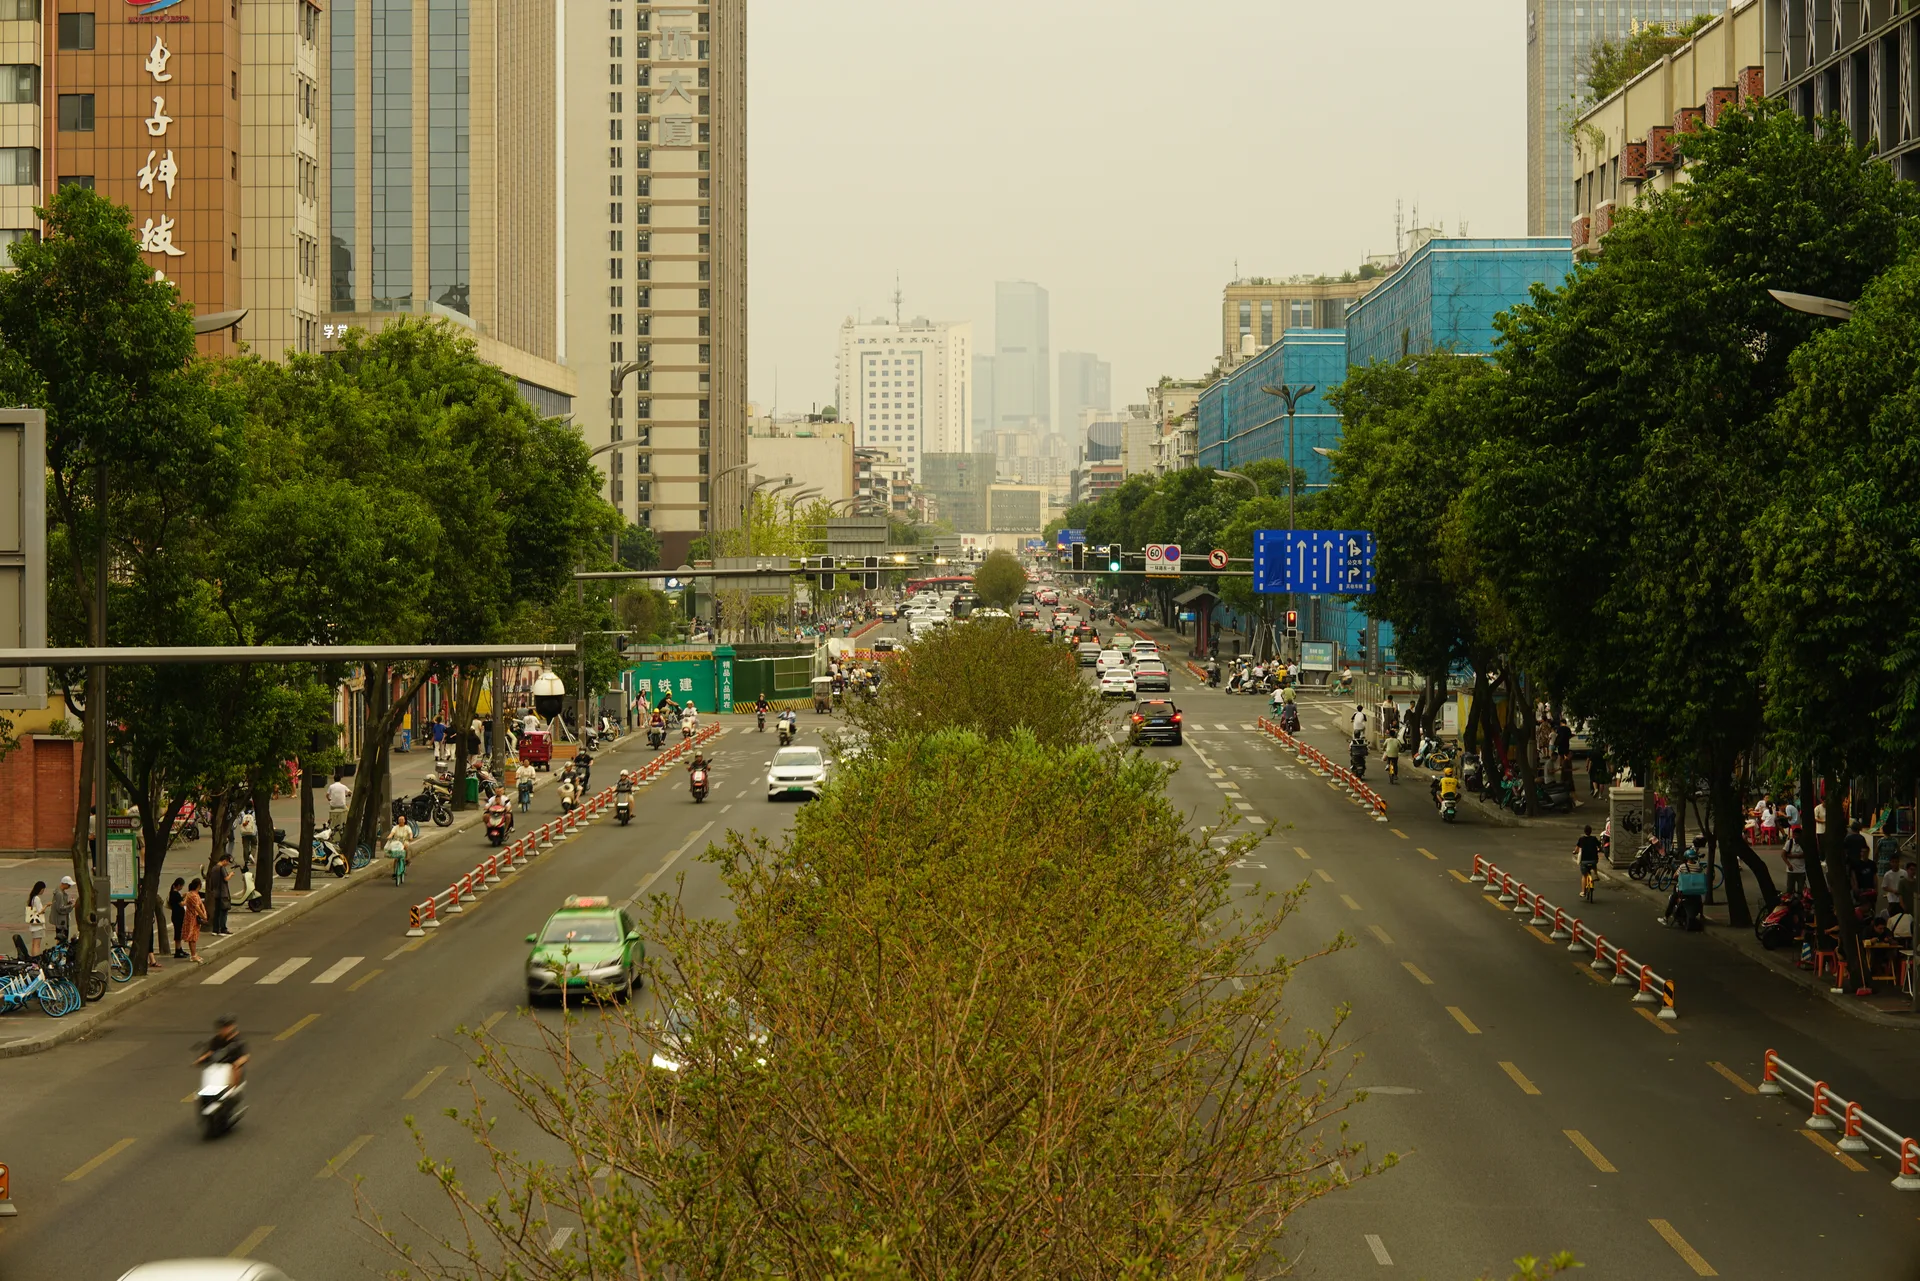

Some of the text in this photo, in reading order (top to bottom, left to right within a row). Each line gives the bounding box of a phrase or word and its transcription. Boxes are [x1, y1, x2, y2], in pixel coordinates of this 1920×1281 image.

[657, 9, 693, 147] 一环大厦
[1150, 549, 1160, 557] 60
